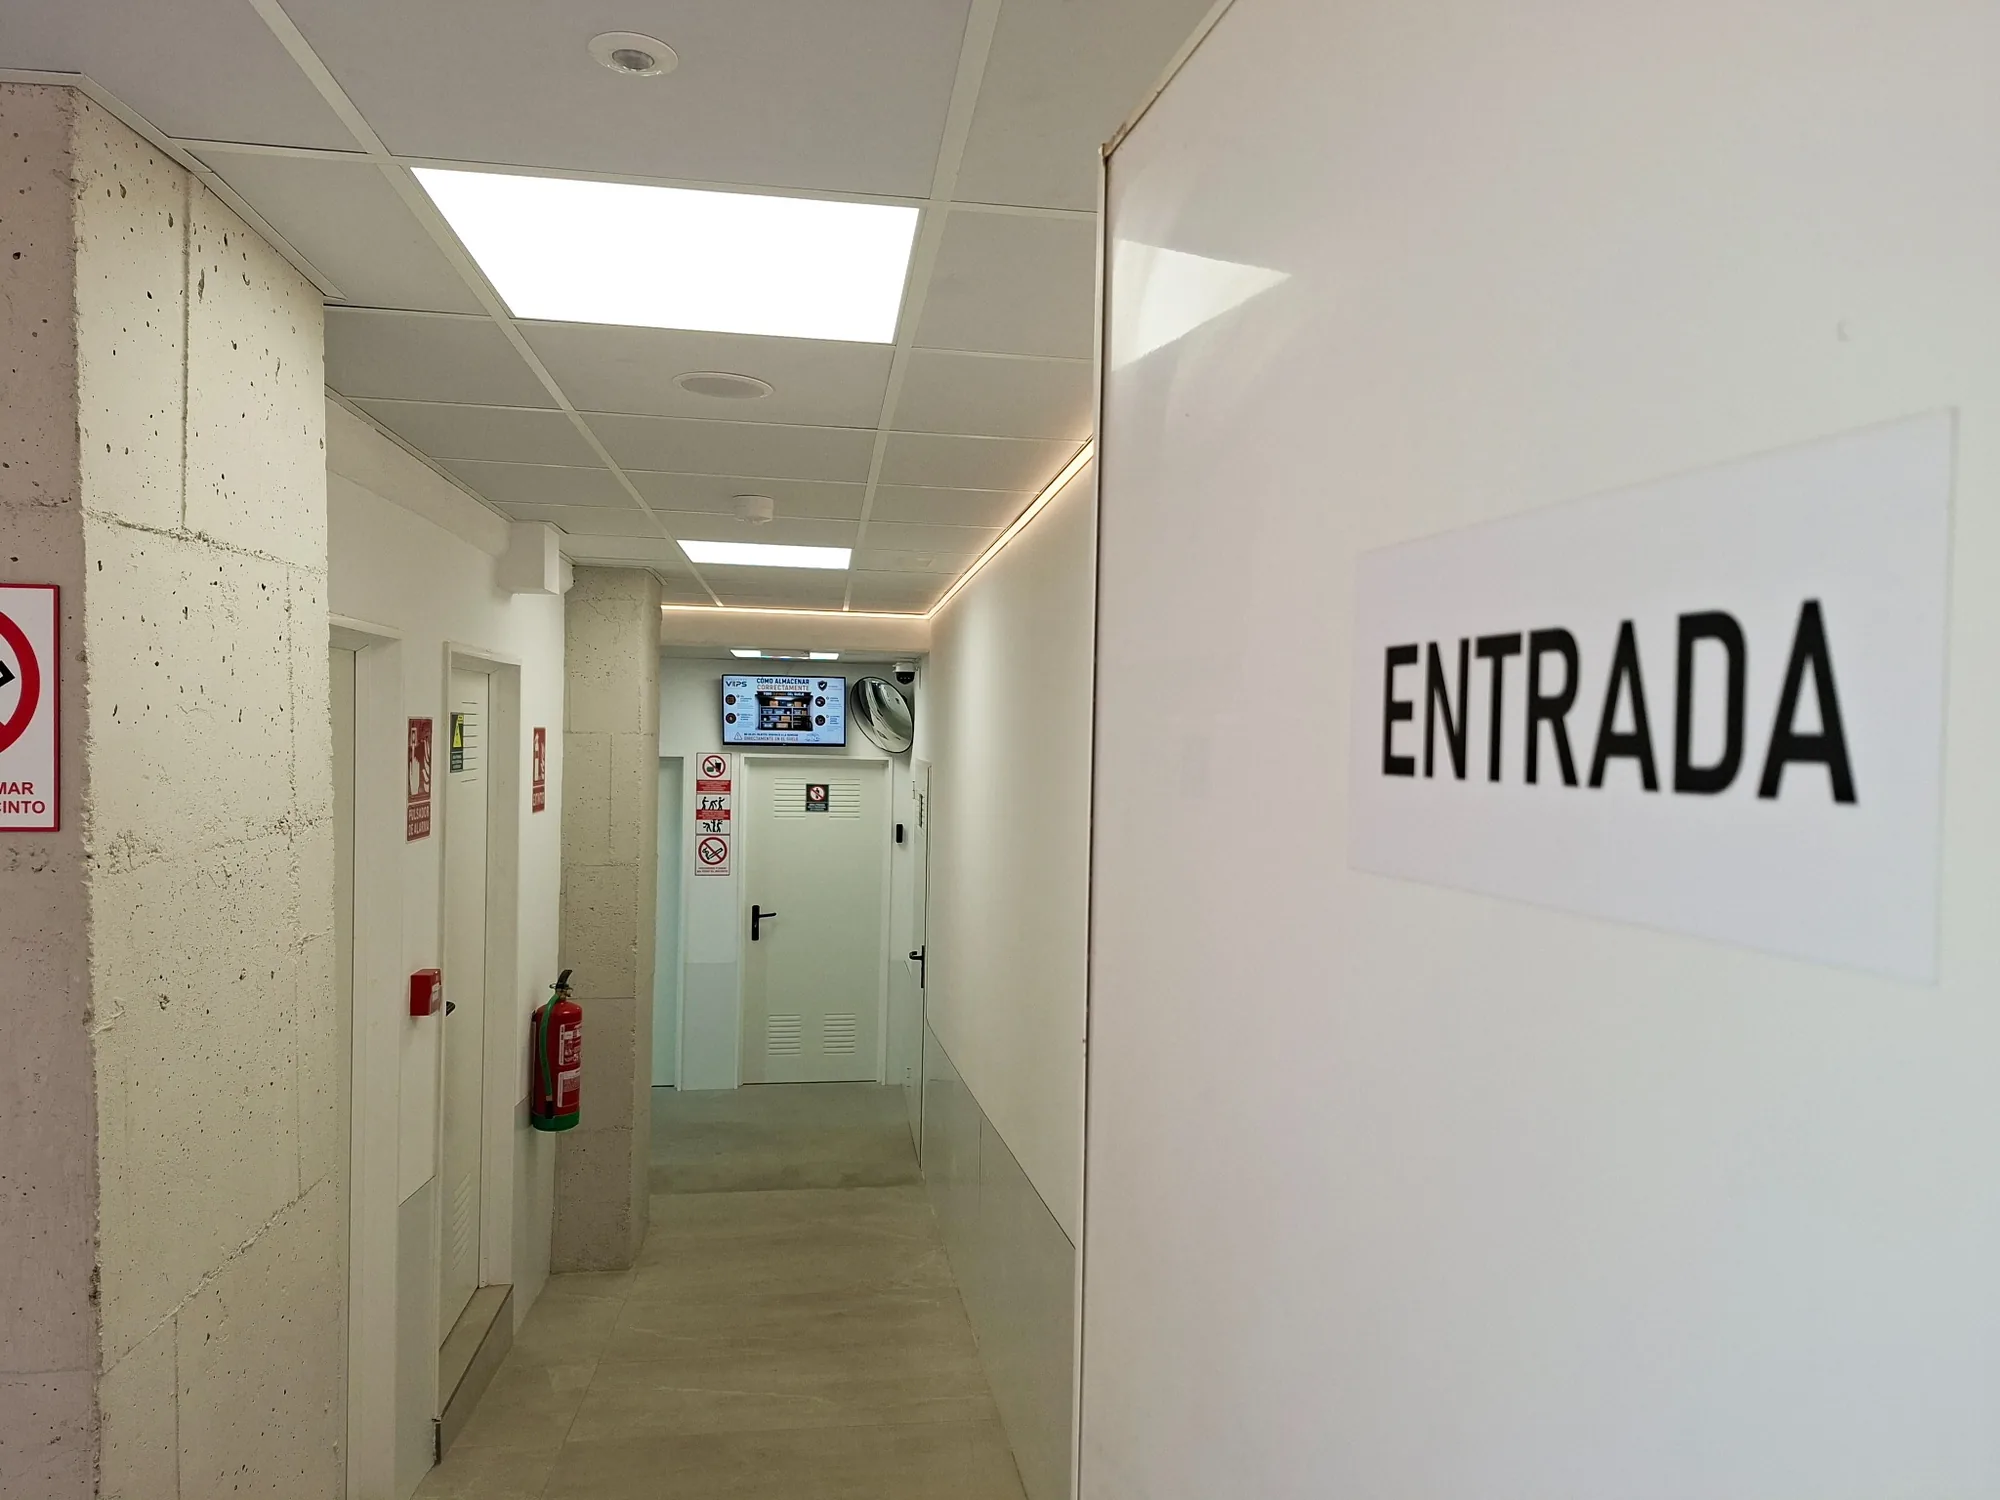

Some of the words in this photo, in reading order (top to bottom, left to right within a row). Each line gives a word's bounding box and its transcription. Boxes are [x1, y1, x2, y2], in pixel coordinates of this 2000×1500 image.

[1382, 598, 1859, 805] ENTRADA
[0, 801, 46, 814] INTO
[408, 806, 430, 821] PULSADOR
